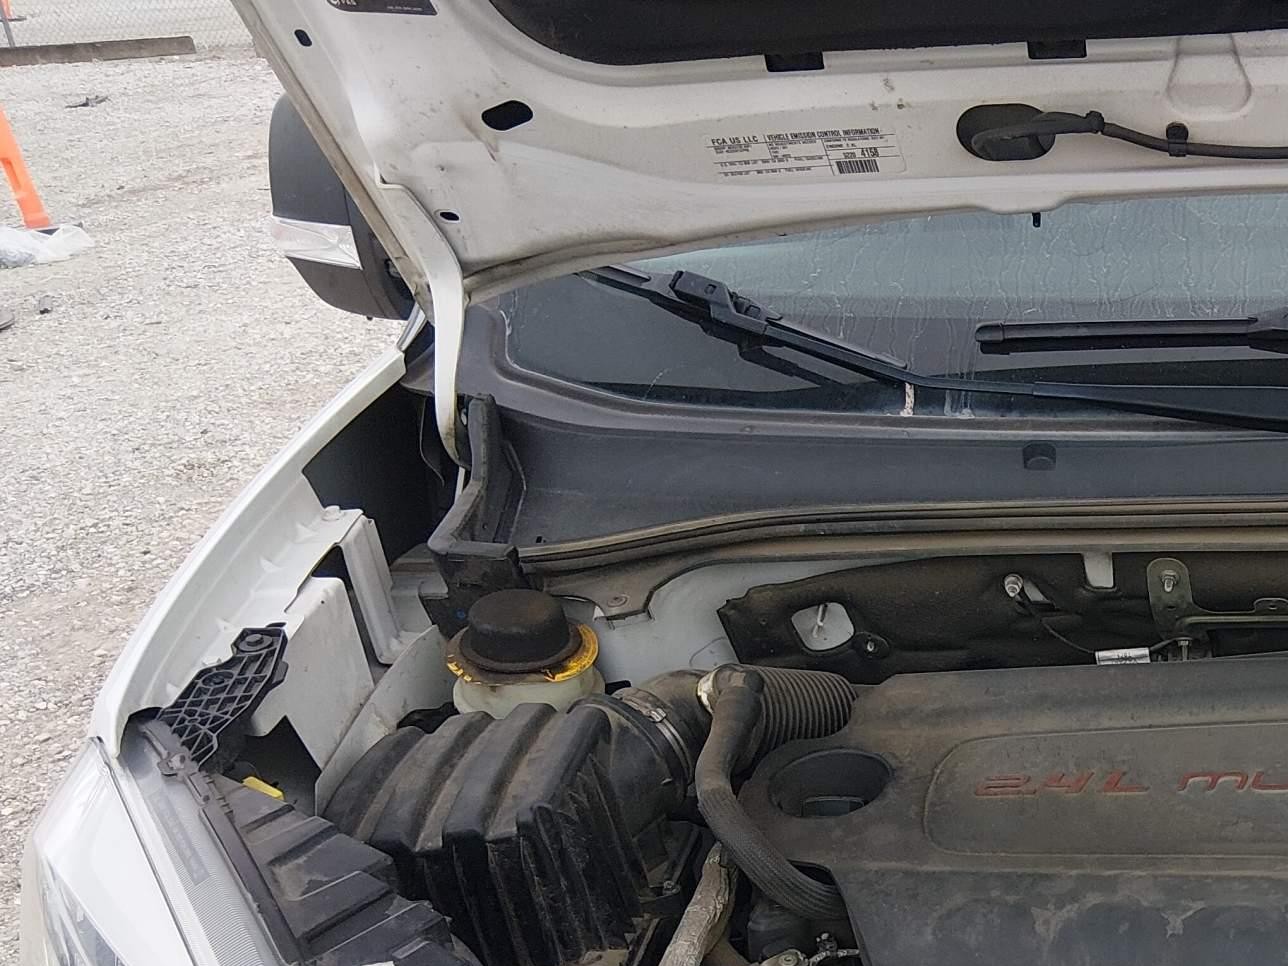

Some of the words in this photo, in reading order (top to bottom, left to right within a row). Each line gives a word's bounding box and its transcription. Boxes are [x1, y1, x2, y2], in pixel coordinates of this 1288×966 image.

[766, 133, 789, 141] VEHICLE
[789, 131, 816, 140] EMISSION
[816, 130, 841, 138] CONTROL
[842, 127, 880, 137] INFORMATION
[711, 137, 728, 146] FCA
[729, 136, 741, 144] US
[742, 135, 759, 144] LLC
